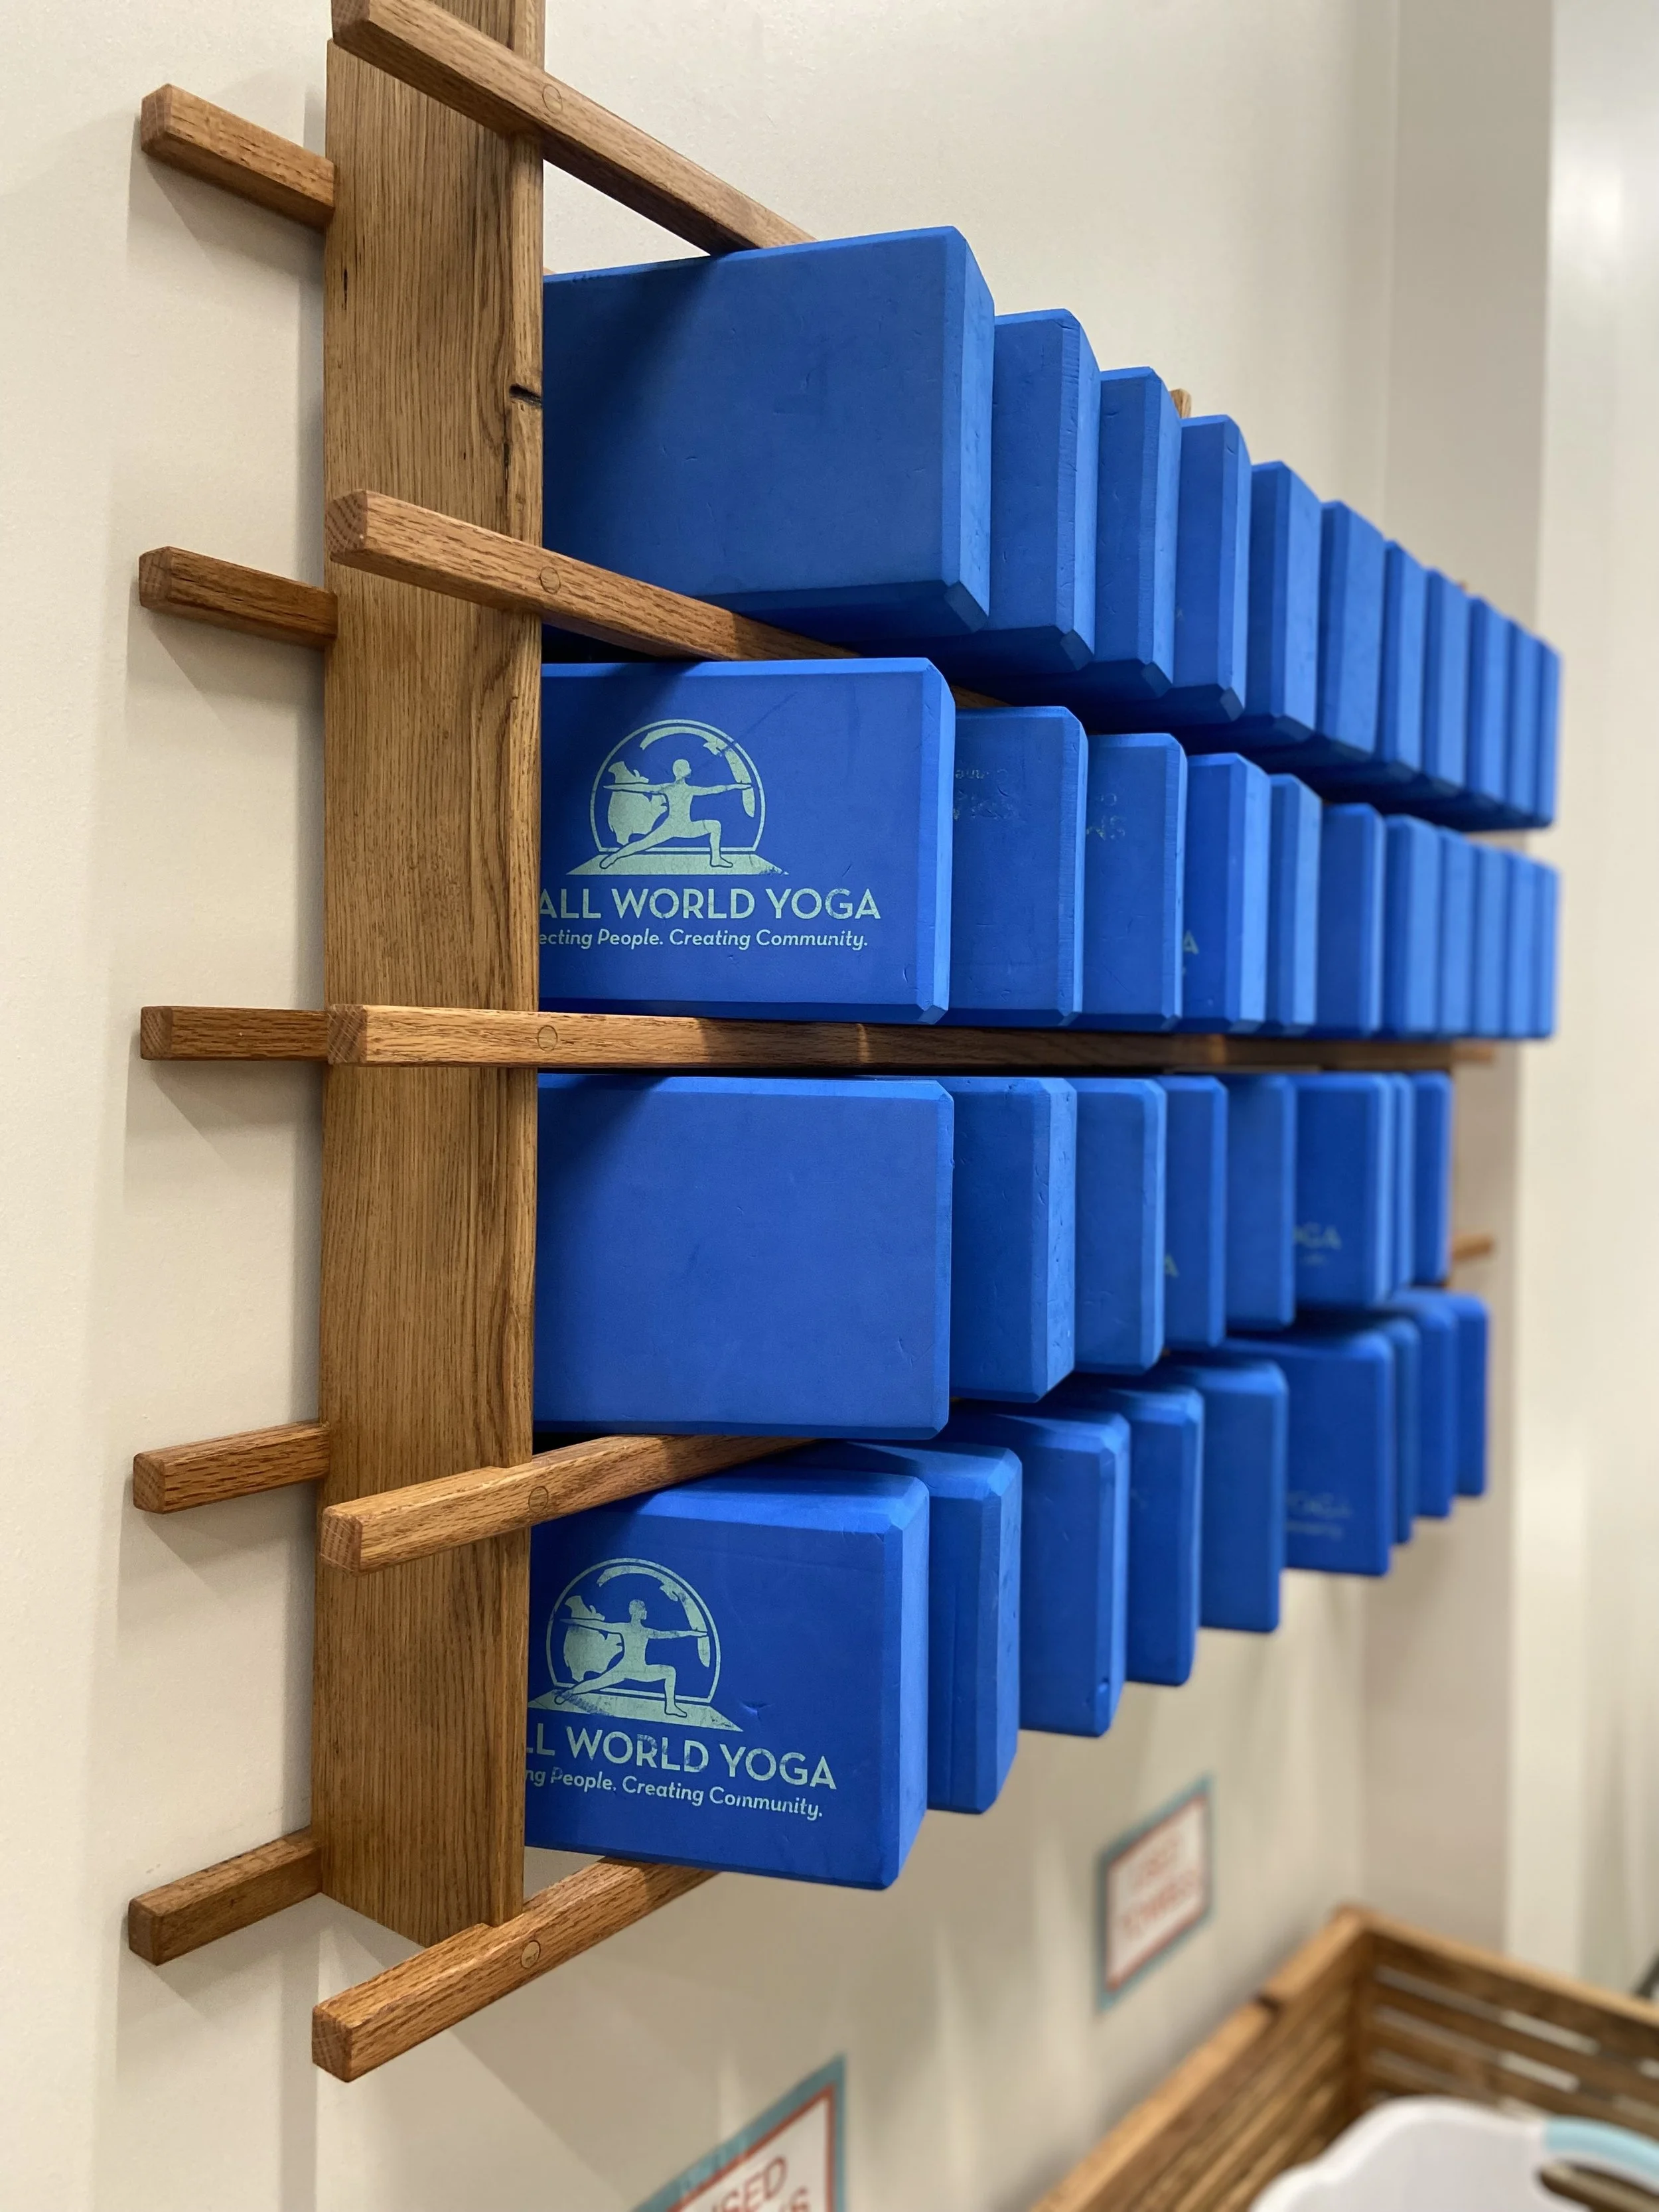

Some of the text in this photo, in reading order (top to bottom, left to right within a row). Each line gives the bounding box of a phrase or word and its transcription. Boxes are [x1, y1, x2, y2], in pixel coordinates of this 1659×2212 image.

[611, 888, 755, 919] WORLD
[765, 888, 881, 919] YOGA
[598, 929, 664, 950] People.
[669, 928, 751, 950] Creating
[756, 929, 869, 951] Community.
[565, 1726, 709, 1773] WORLD
[720, 1743, 837, 1791] YOGA
[550, 1766, 617, 1793] People.
[622, 1775, 705, 1806] Creating
[709, 1786, 824, 1821] Community.
